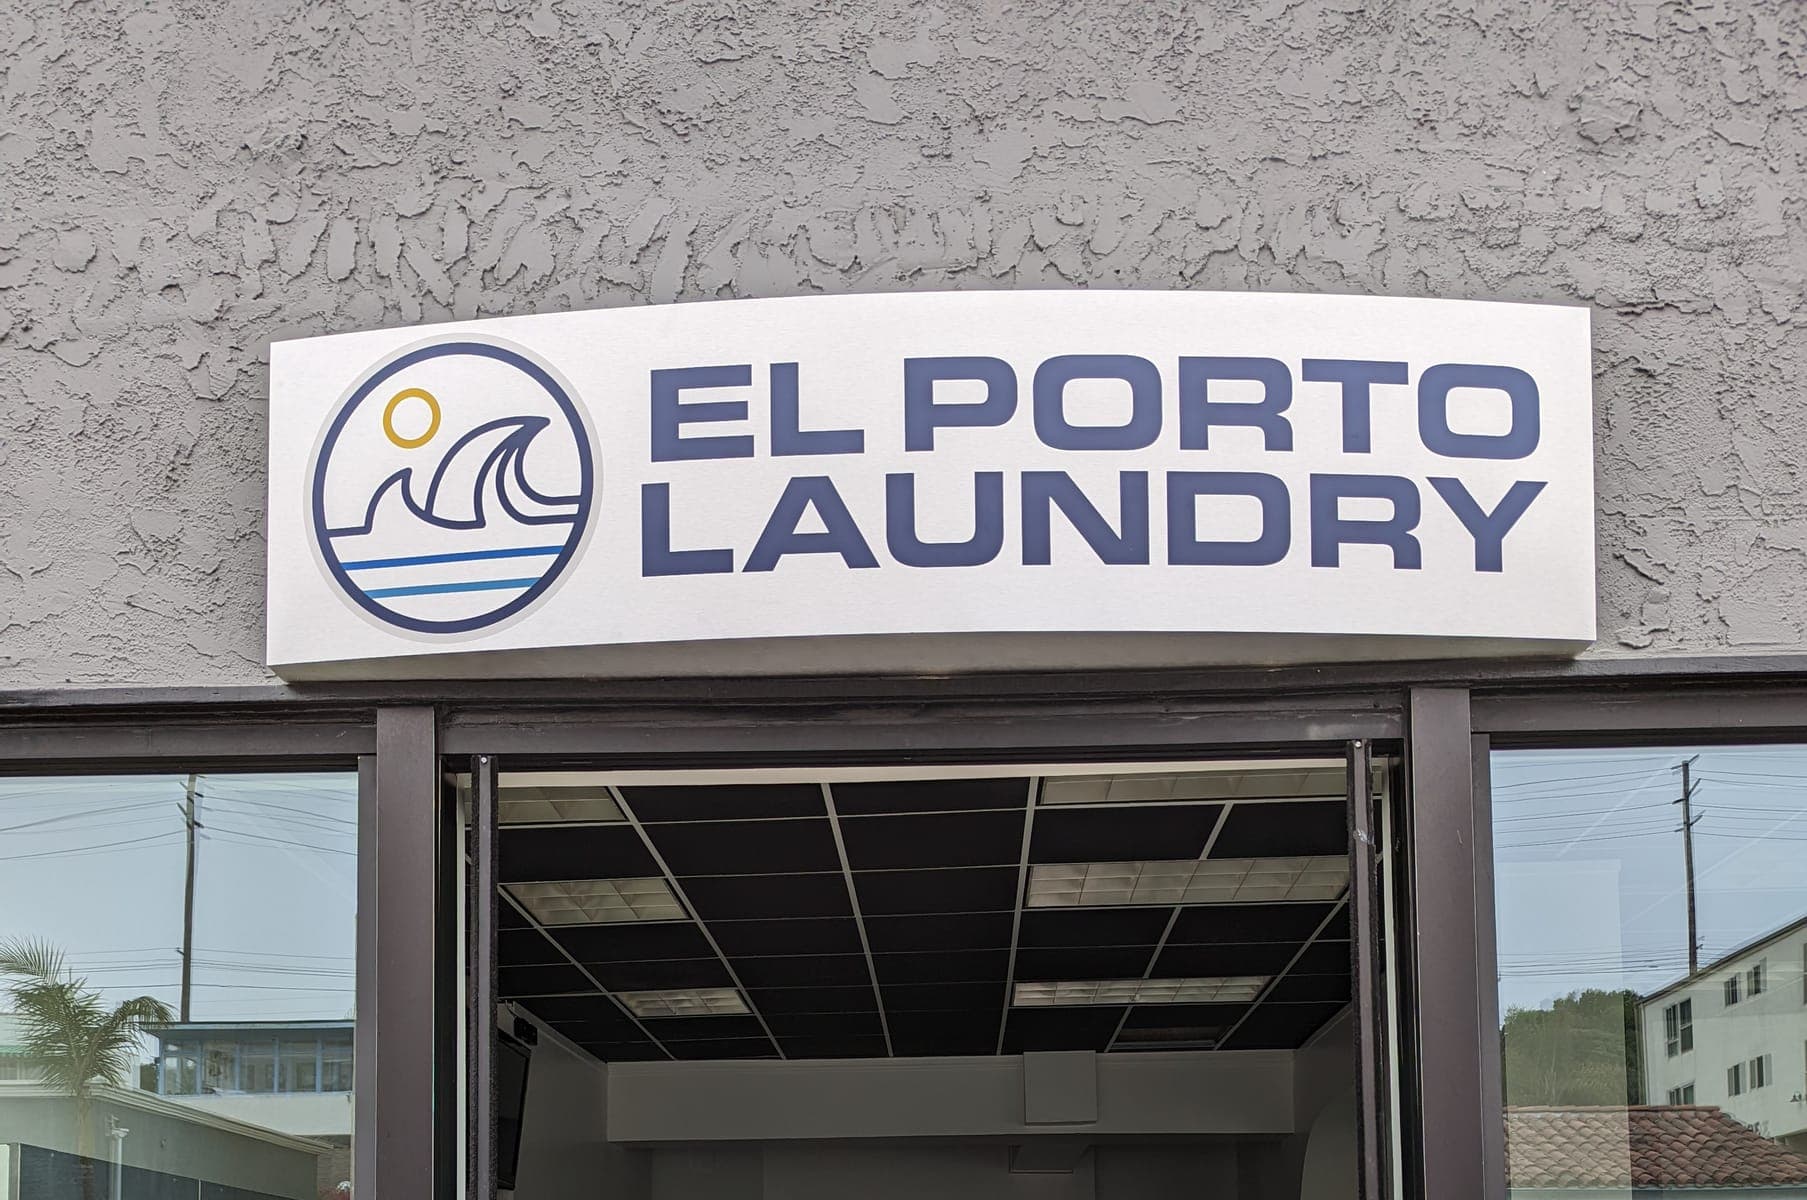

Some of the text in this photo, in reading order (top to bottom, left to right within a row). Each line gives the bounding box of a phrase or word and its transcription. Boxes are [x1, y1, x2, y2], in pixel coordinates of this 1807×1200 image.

[651, 355, 1541, 462] EL PORTO
[642, 471, 1547, 577] LAUNDRY
